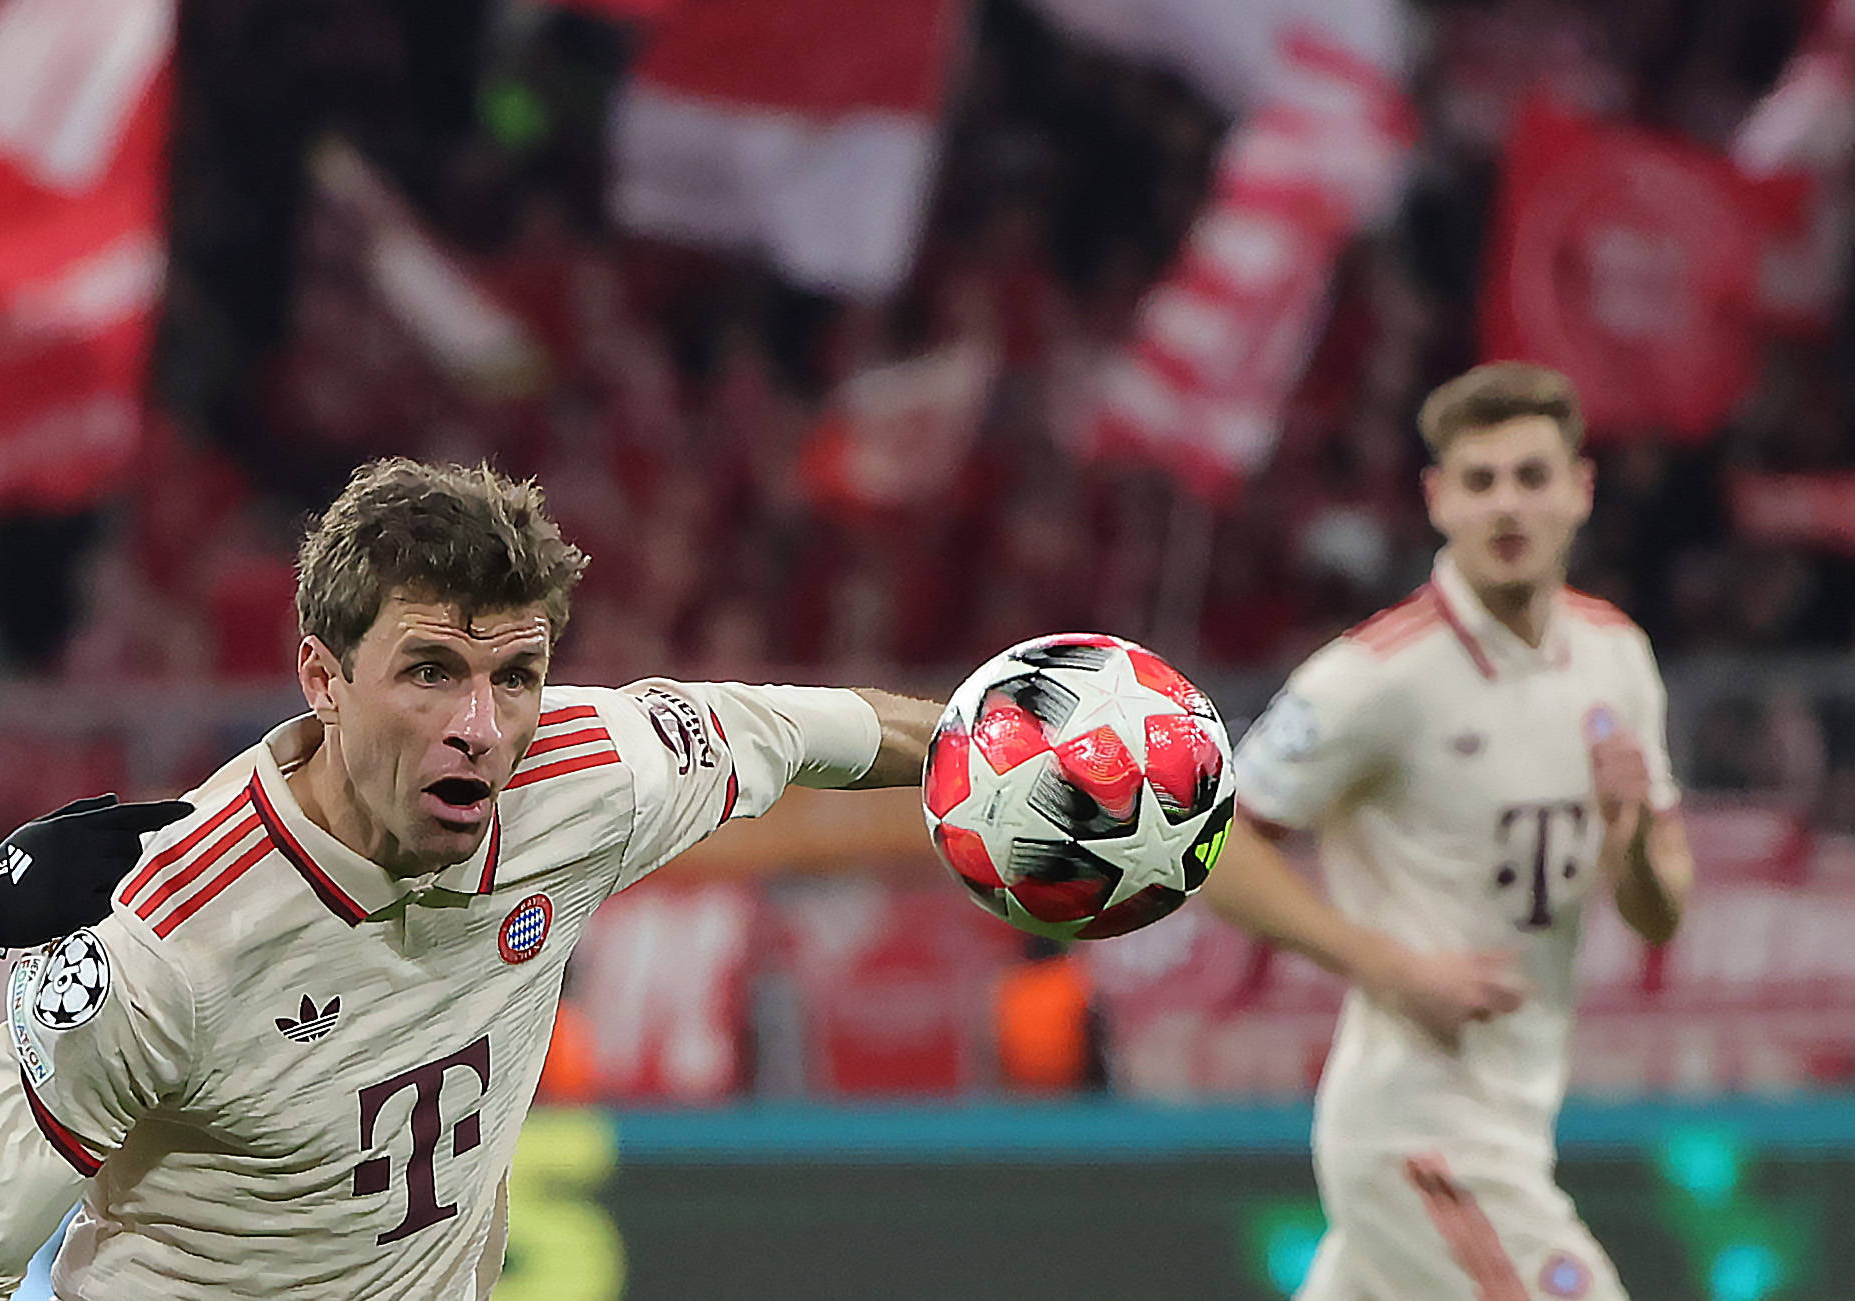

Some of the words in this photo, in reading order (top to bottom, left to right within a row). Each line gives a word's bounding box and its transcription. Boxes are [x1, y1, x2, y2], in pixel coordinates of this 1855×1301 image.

[12, 959, 47, 1080] FOUNDATION
[27, 957, 42, 982] UEFA
[352, 1034, 490, 1246] T
